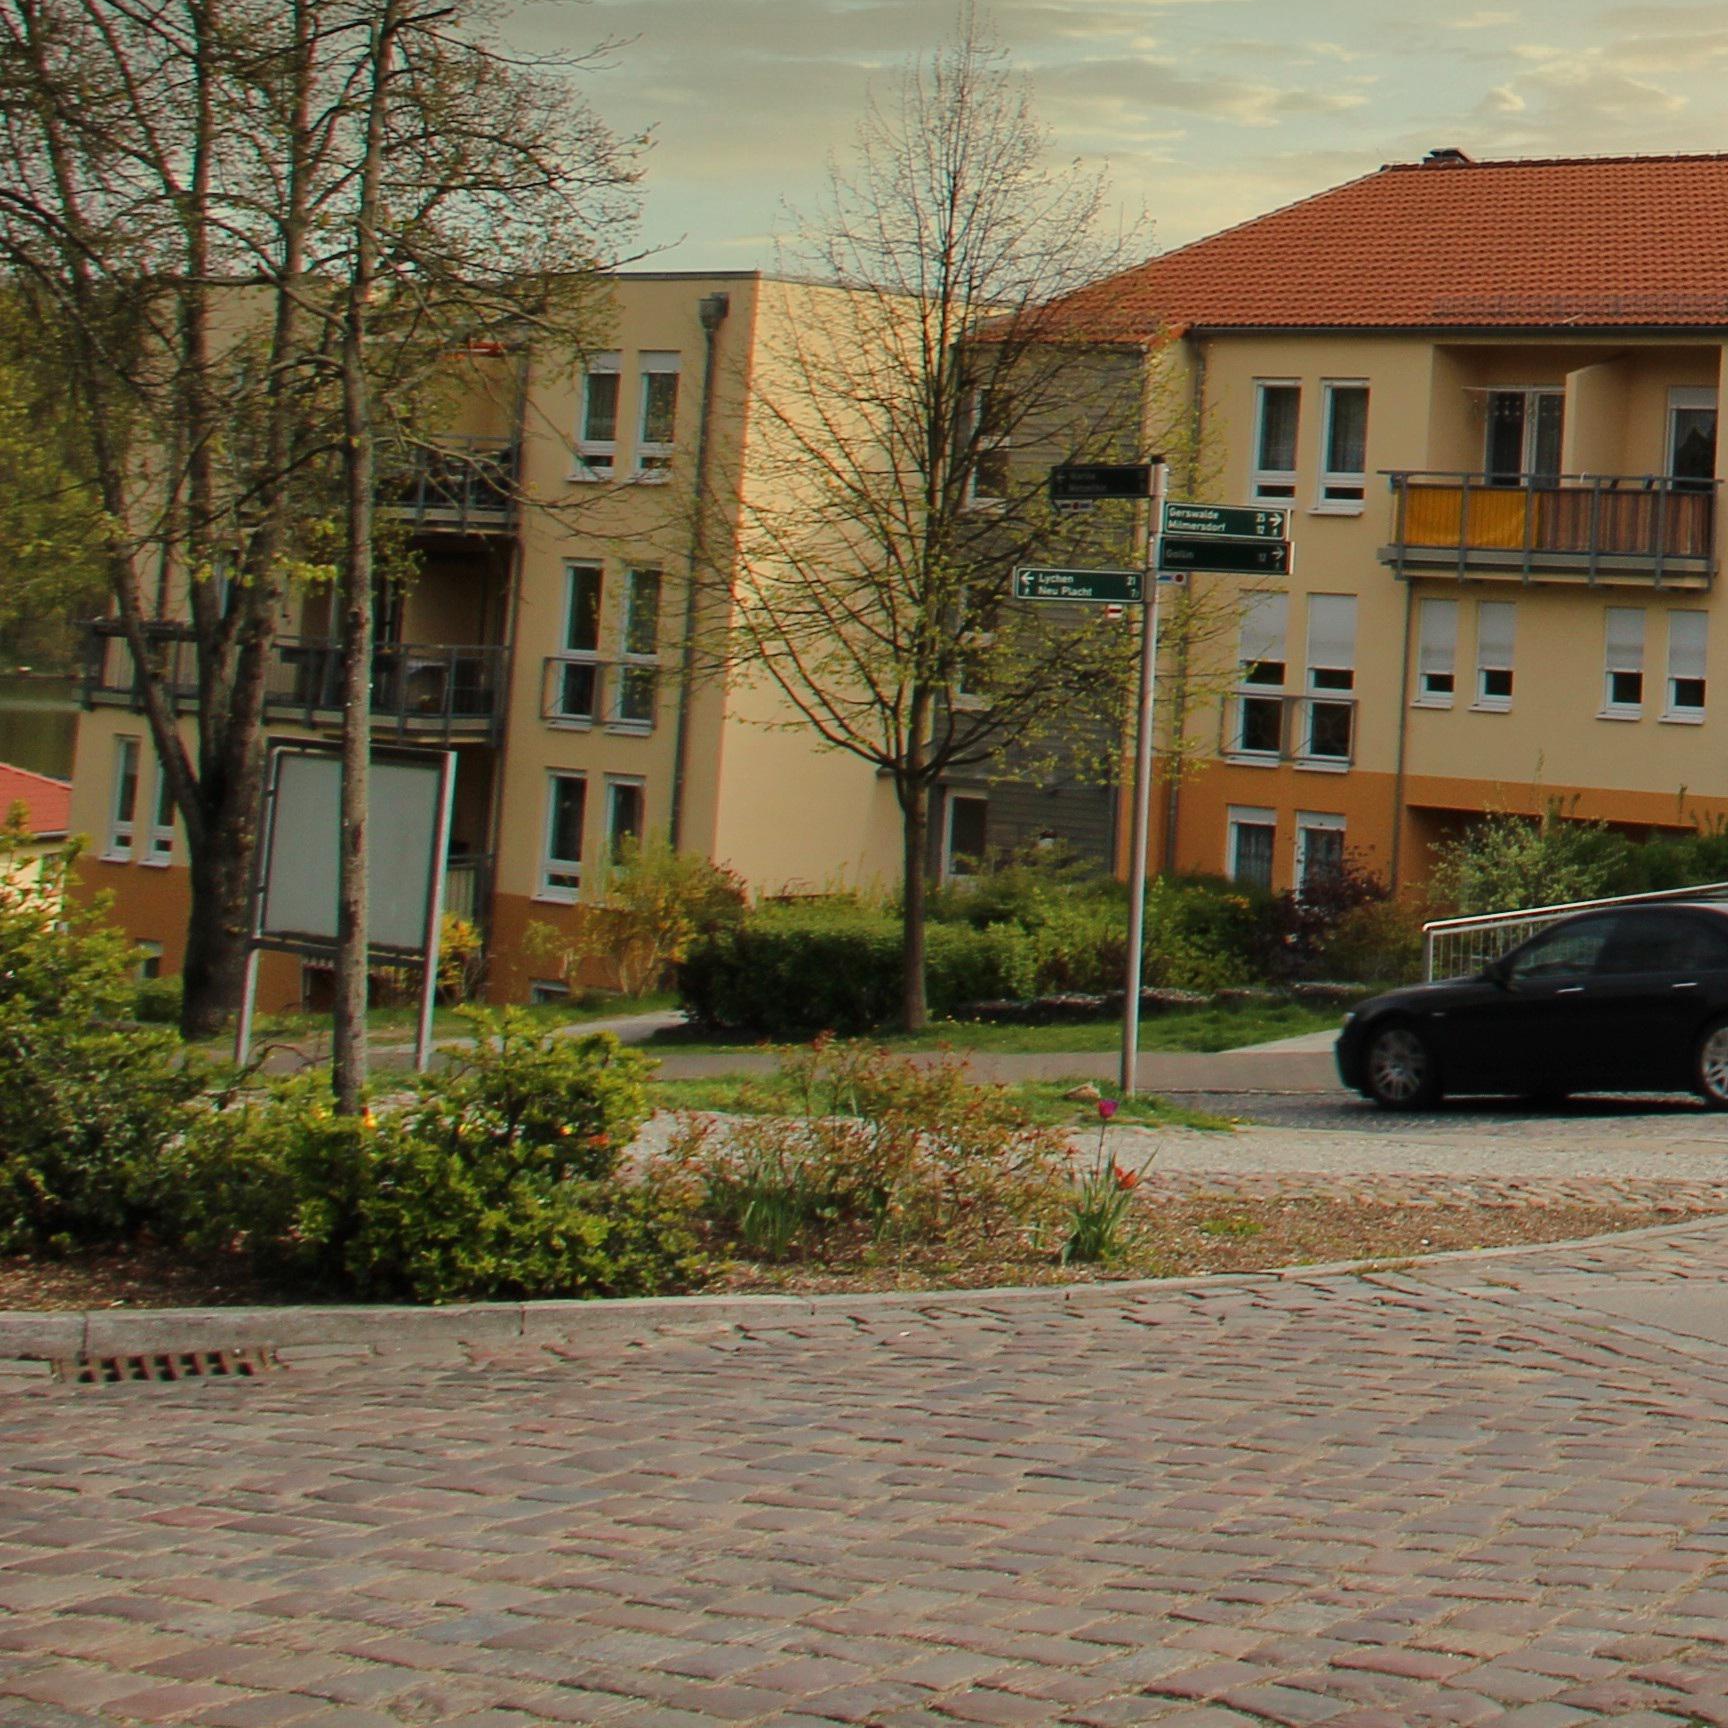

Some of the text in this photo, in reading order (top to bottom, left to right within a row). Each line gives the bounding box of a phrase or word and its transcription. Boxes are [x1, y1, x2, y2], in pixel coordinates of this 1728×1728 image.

[1168, 507, 1219, 520] Gerswalde
[1167, 520, 1226, 532] Milmersdorf
[1038, 573, 1074, 585] Lychen
[1038, 586, 1059, 596] Neu
